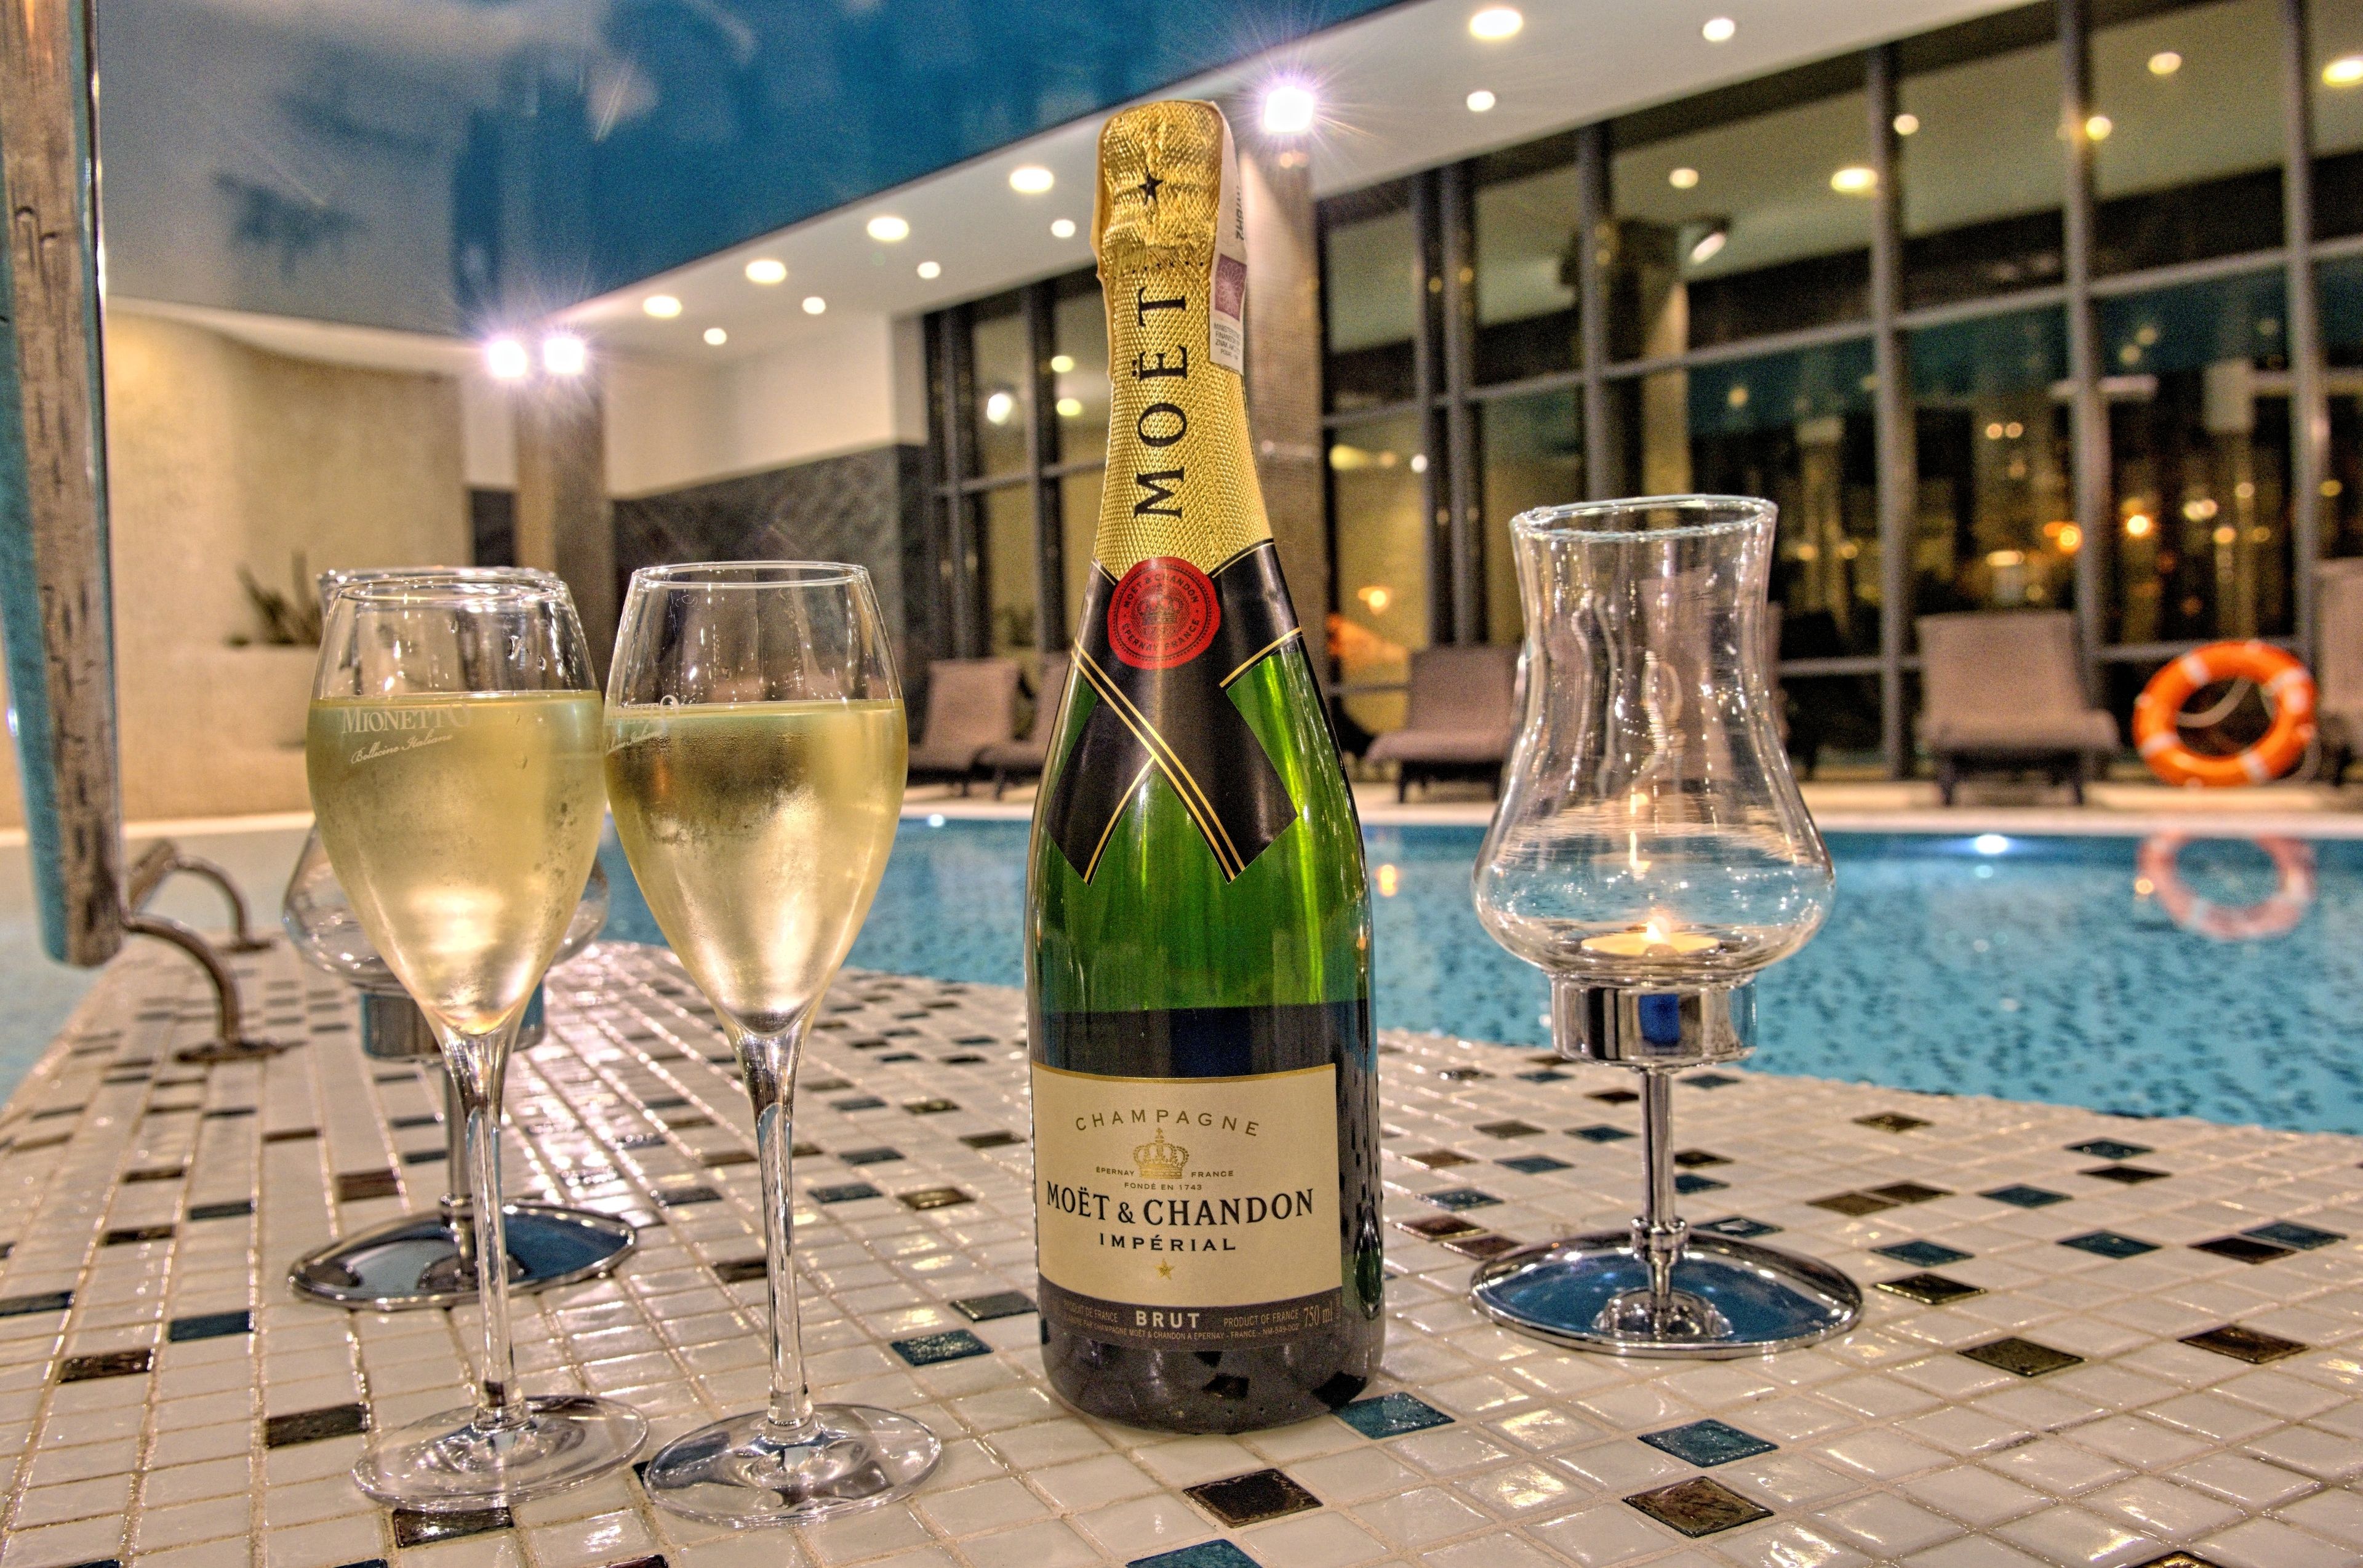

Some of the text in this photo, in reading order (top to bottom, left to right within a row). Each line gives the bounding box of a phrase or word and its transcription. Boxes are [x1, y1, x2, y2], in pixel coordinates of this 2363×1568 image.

[1132, 287, 1188, 519] MOËT
[1154, 574, 1199, 603] CHANDON
[1164, 619, 1200, 650] FRANCE
[1076, 1110, 1258, 1137] CHAMPAGNE
[1096, 1166, 1135, 1176] ÉPERNAY
[1124, 1182, 1156, 1190] FONDÉ
[1047, 1180, 1314, 1226] MOËT & CHANDON
[1100, 1233, 1236, 1252] IMPÉRIAL
[1094, 1309, 1118, 1323] FRANCE
[1136, 1310, 1199, 1329] BRUT
[1223, 1310, 1298, 1327] PRODUCT OF FRANCE
[1304, 1305, 1319, 1328] 750
[1322, 1300, 1332, 1323] ml
[1148, 1330, 1153, 1338] &
[1154, 1331, 1185, 1340] CHANDON
[1231, 1330, 1256, 1338] FRANCE
